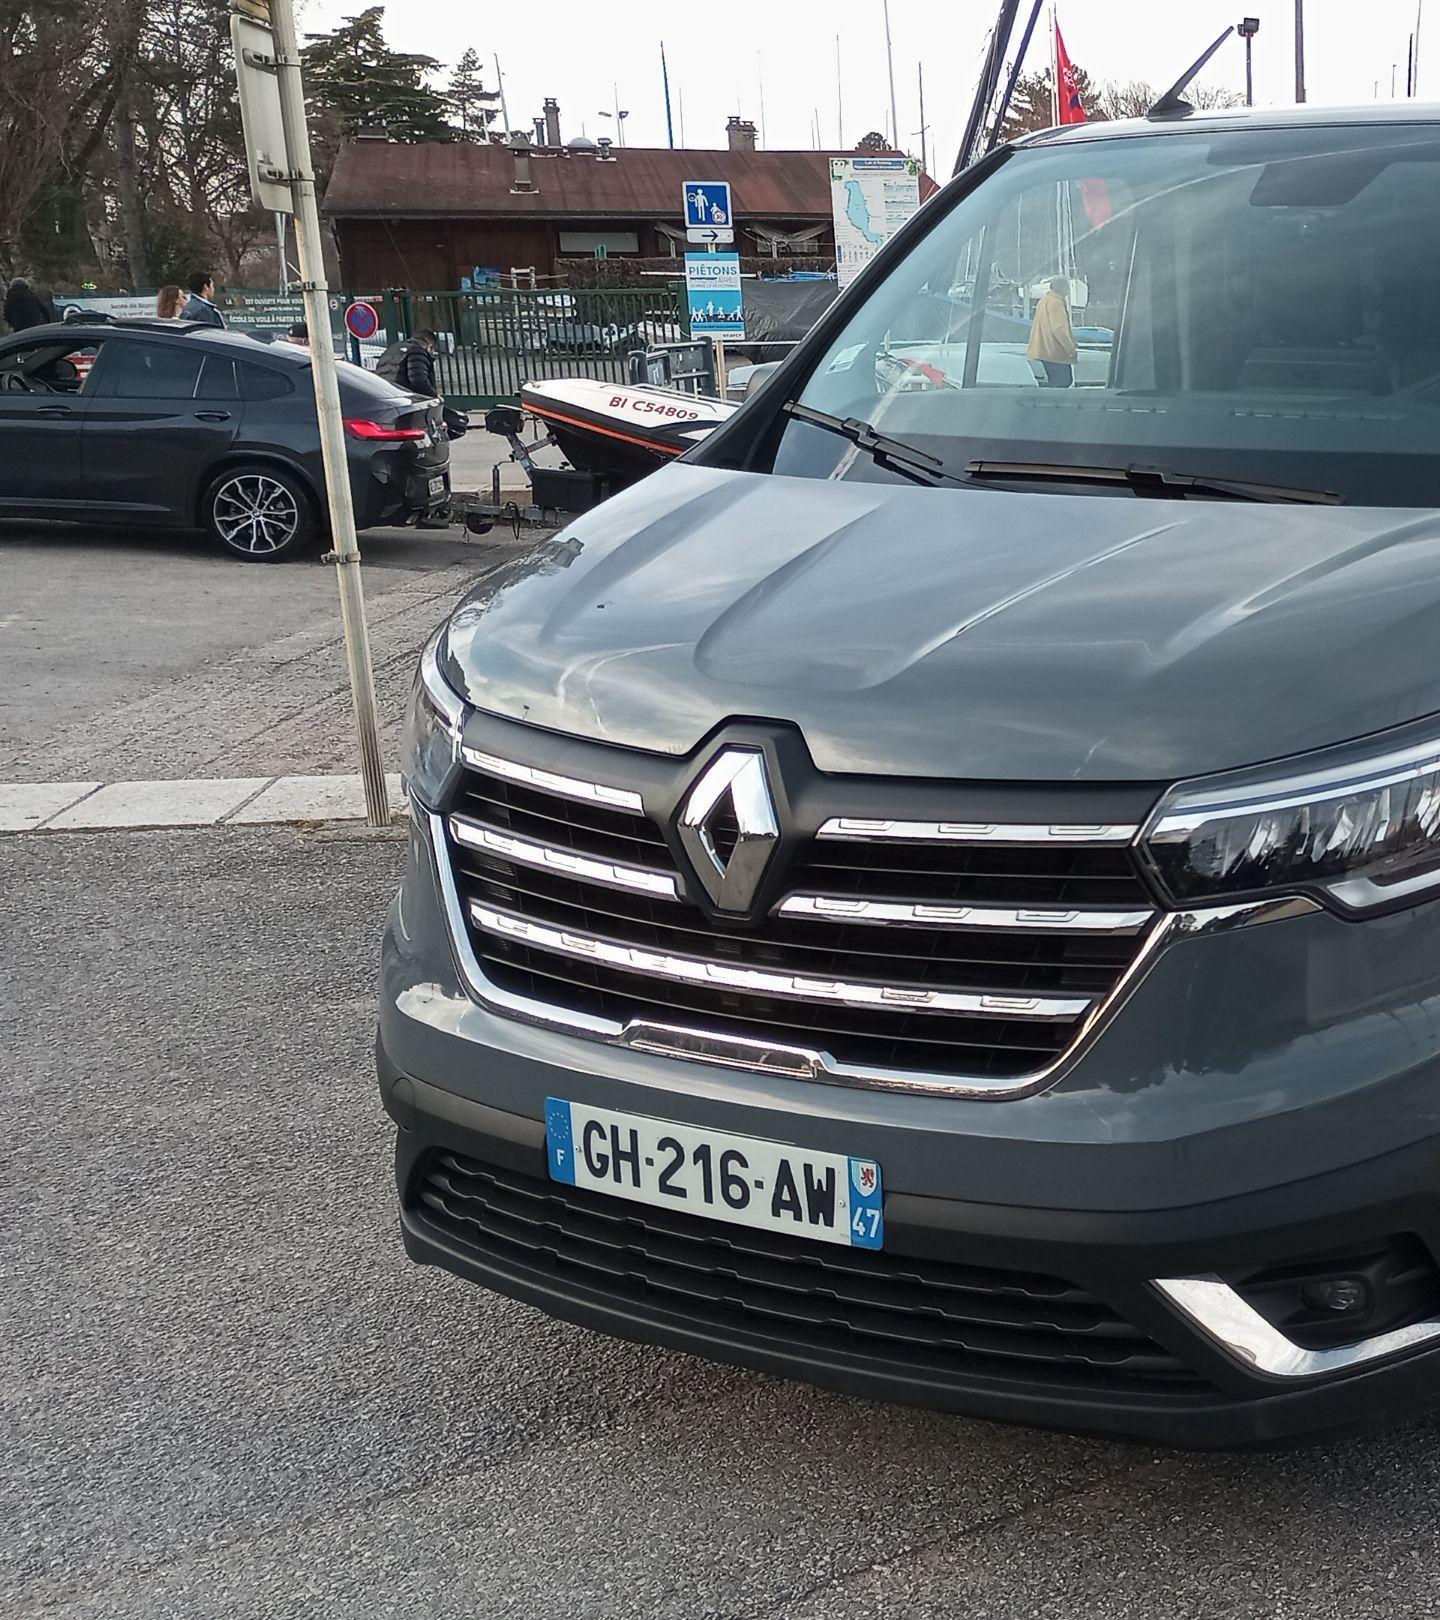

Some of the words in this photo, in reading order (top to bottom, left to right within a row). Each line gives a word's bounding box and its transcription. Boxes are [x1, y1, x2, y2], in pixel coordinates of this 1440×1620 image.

[688, 263, 738, 275] PIÉTONS
[609, 396, 628, 409] BI
[632, 399, 699, 421] C54809
[556, 1148, 565, 1166] F
[582, 1119, 837, 1229] GH-216-AW
[851, 1206, 882, 1240] 47
